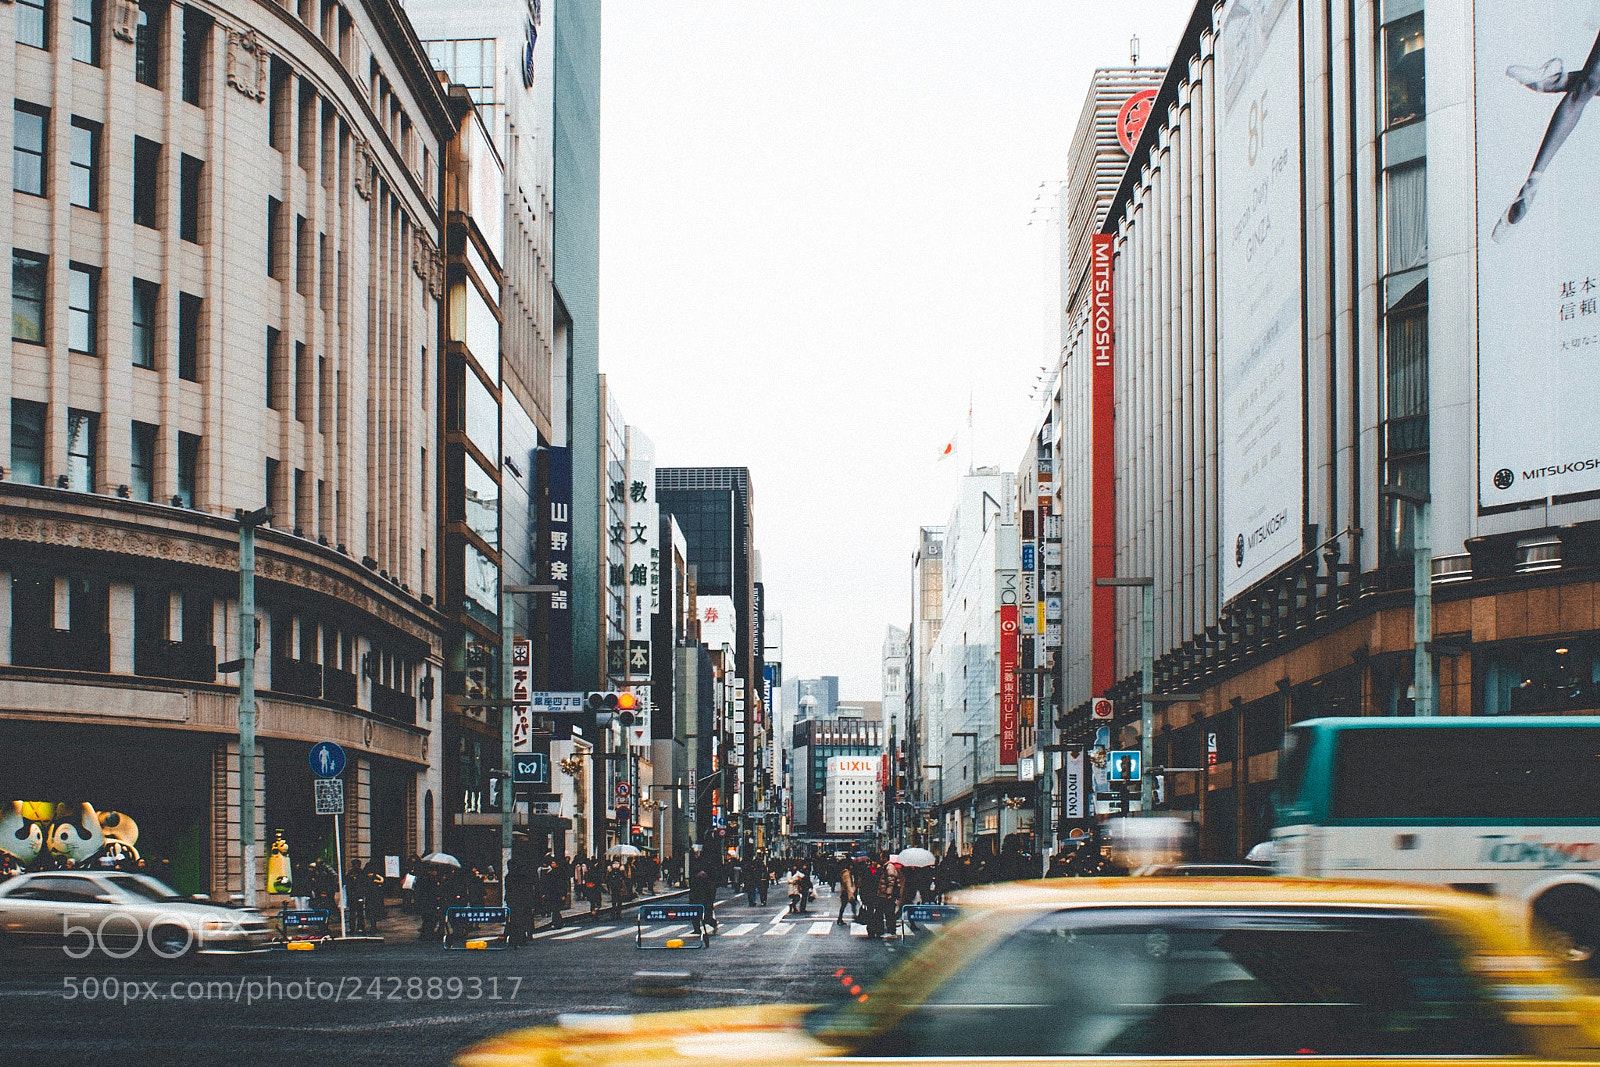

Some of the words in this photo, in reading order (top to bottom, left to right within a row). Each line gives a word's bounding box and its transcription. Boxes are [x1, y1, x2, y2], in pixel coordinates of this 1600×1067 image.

[1248, 88, 1268, 167] 8F
[1095, 242, 1110, 367] MITSUKOSHI
[550, 501, 568, 610] 山野楽器
[629, 479, 648, 587] 教文館
[1247, 507, 1287, 551] MITSUKOSHI
[704, 607, 719, 623] 券
[630, 645, 647, 669] 本
[534, 697, 581, 706] 銀座四丁目
[1004, 661, 1014, 751] 三菱東京UFJ銀行
[840, 761, 871, 772] LIXIL
